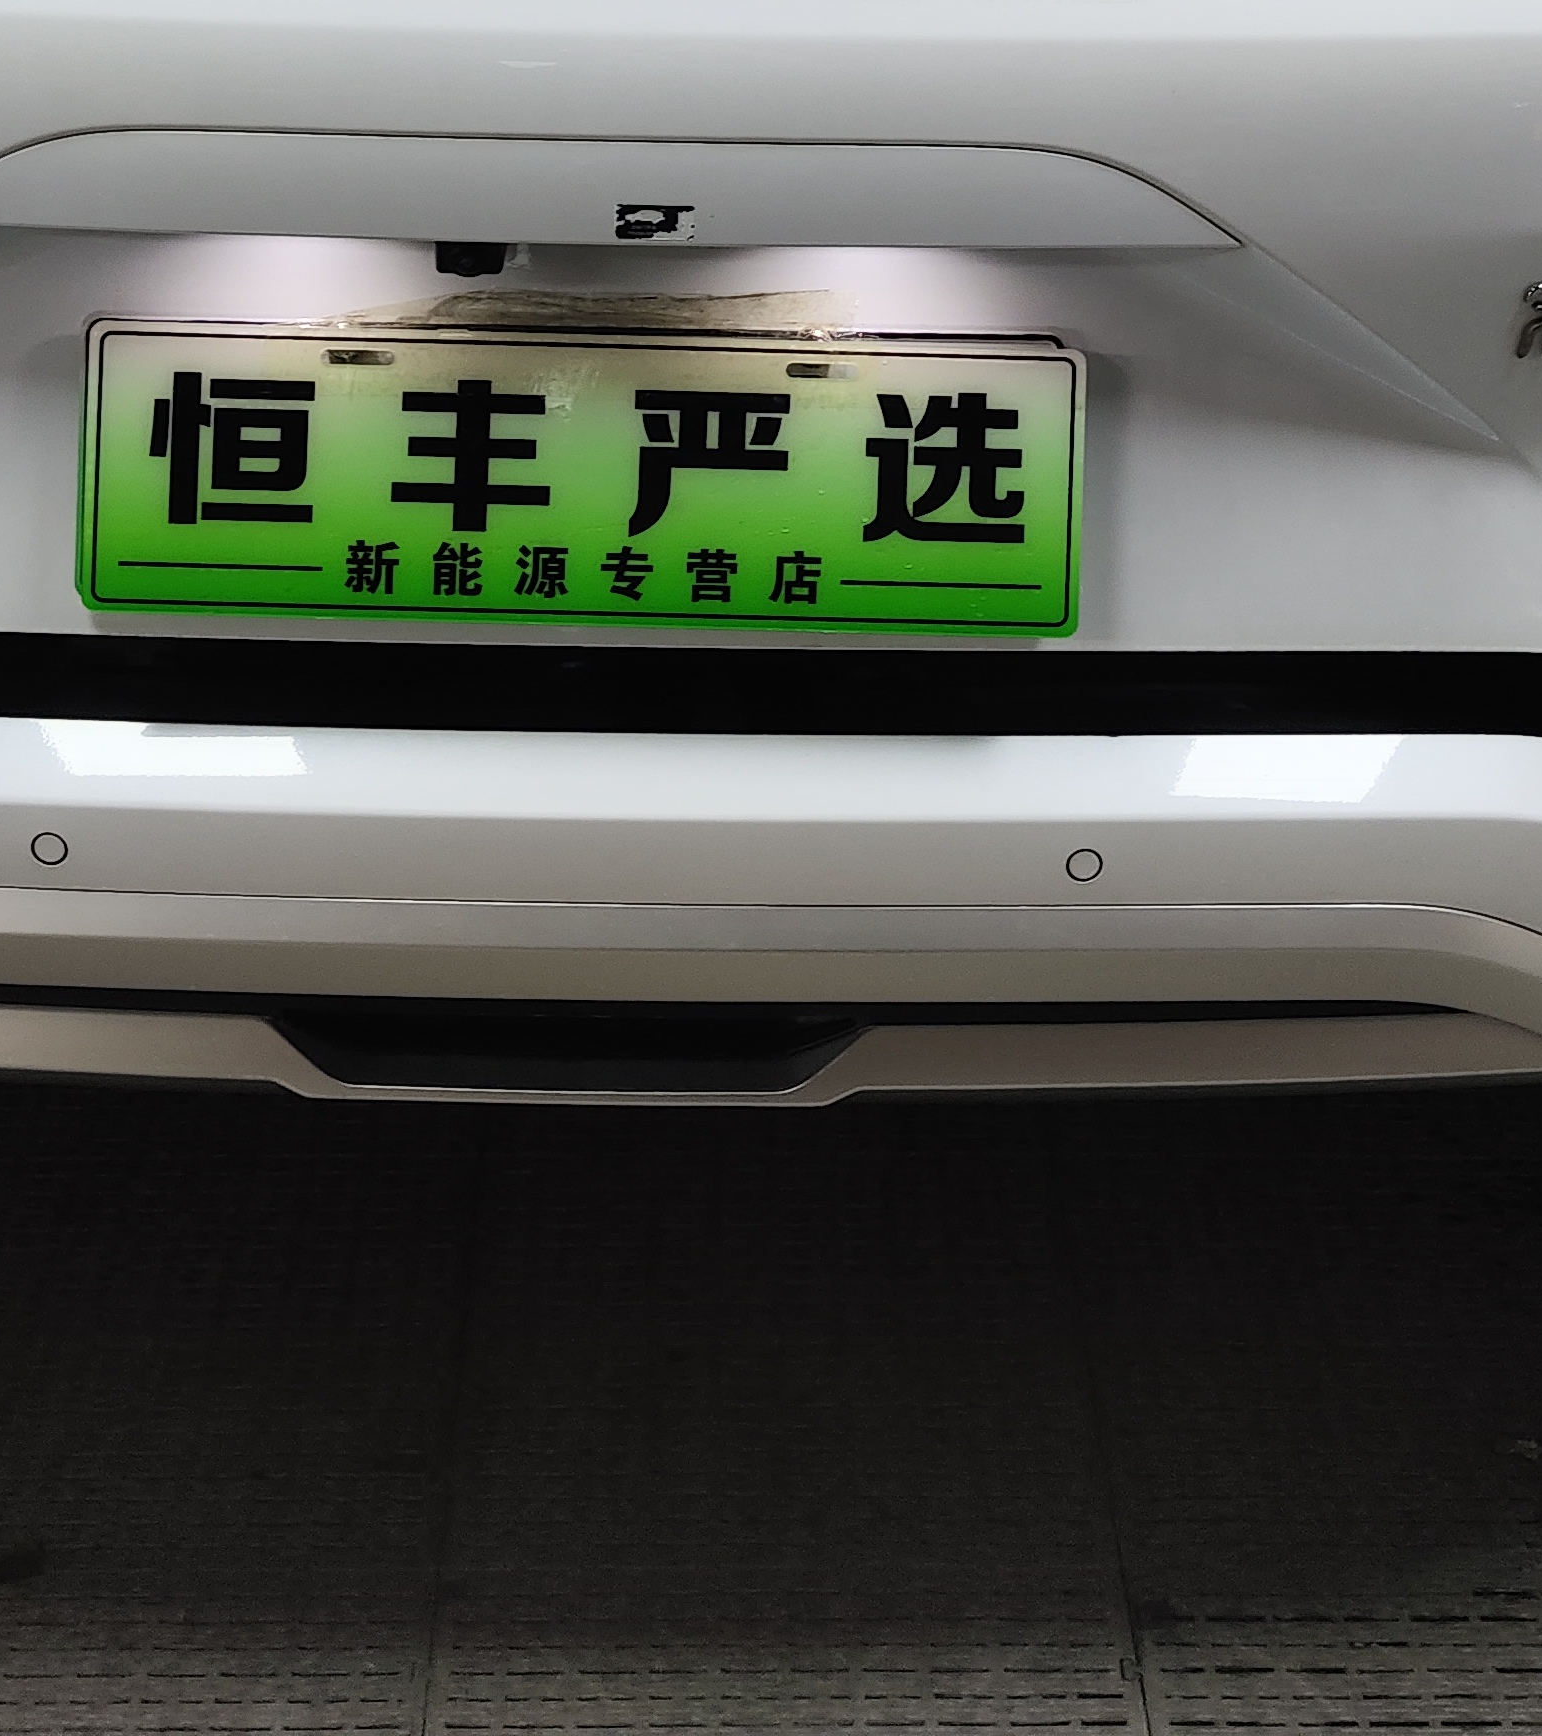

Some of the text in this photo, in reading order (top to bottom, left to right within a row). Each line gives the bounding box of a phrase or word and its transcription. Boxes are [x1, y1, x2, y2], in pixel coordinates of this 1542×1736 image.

[149, 371, 1028, 544] 恒丰严选
[344, 540, 823, 604] 新能源专营店
